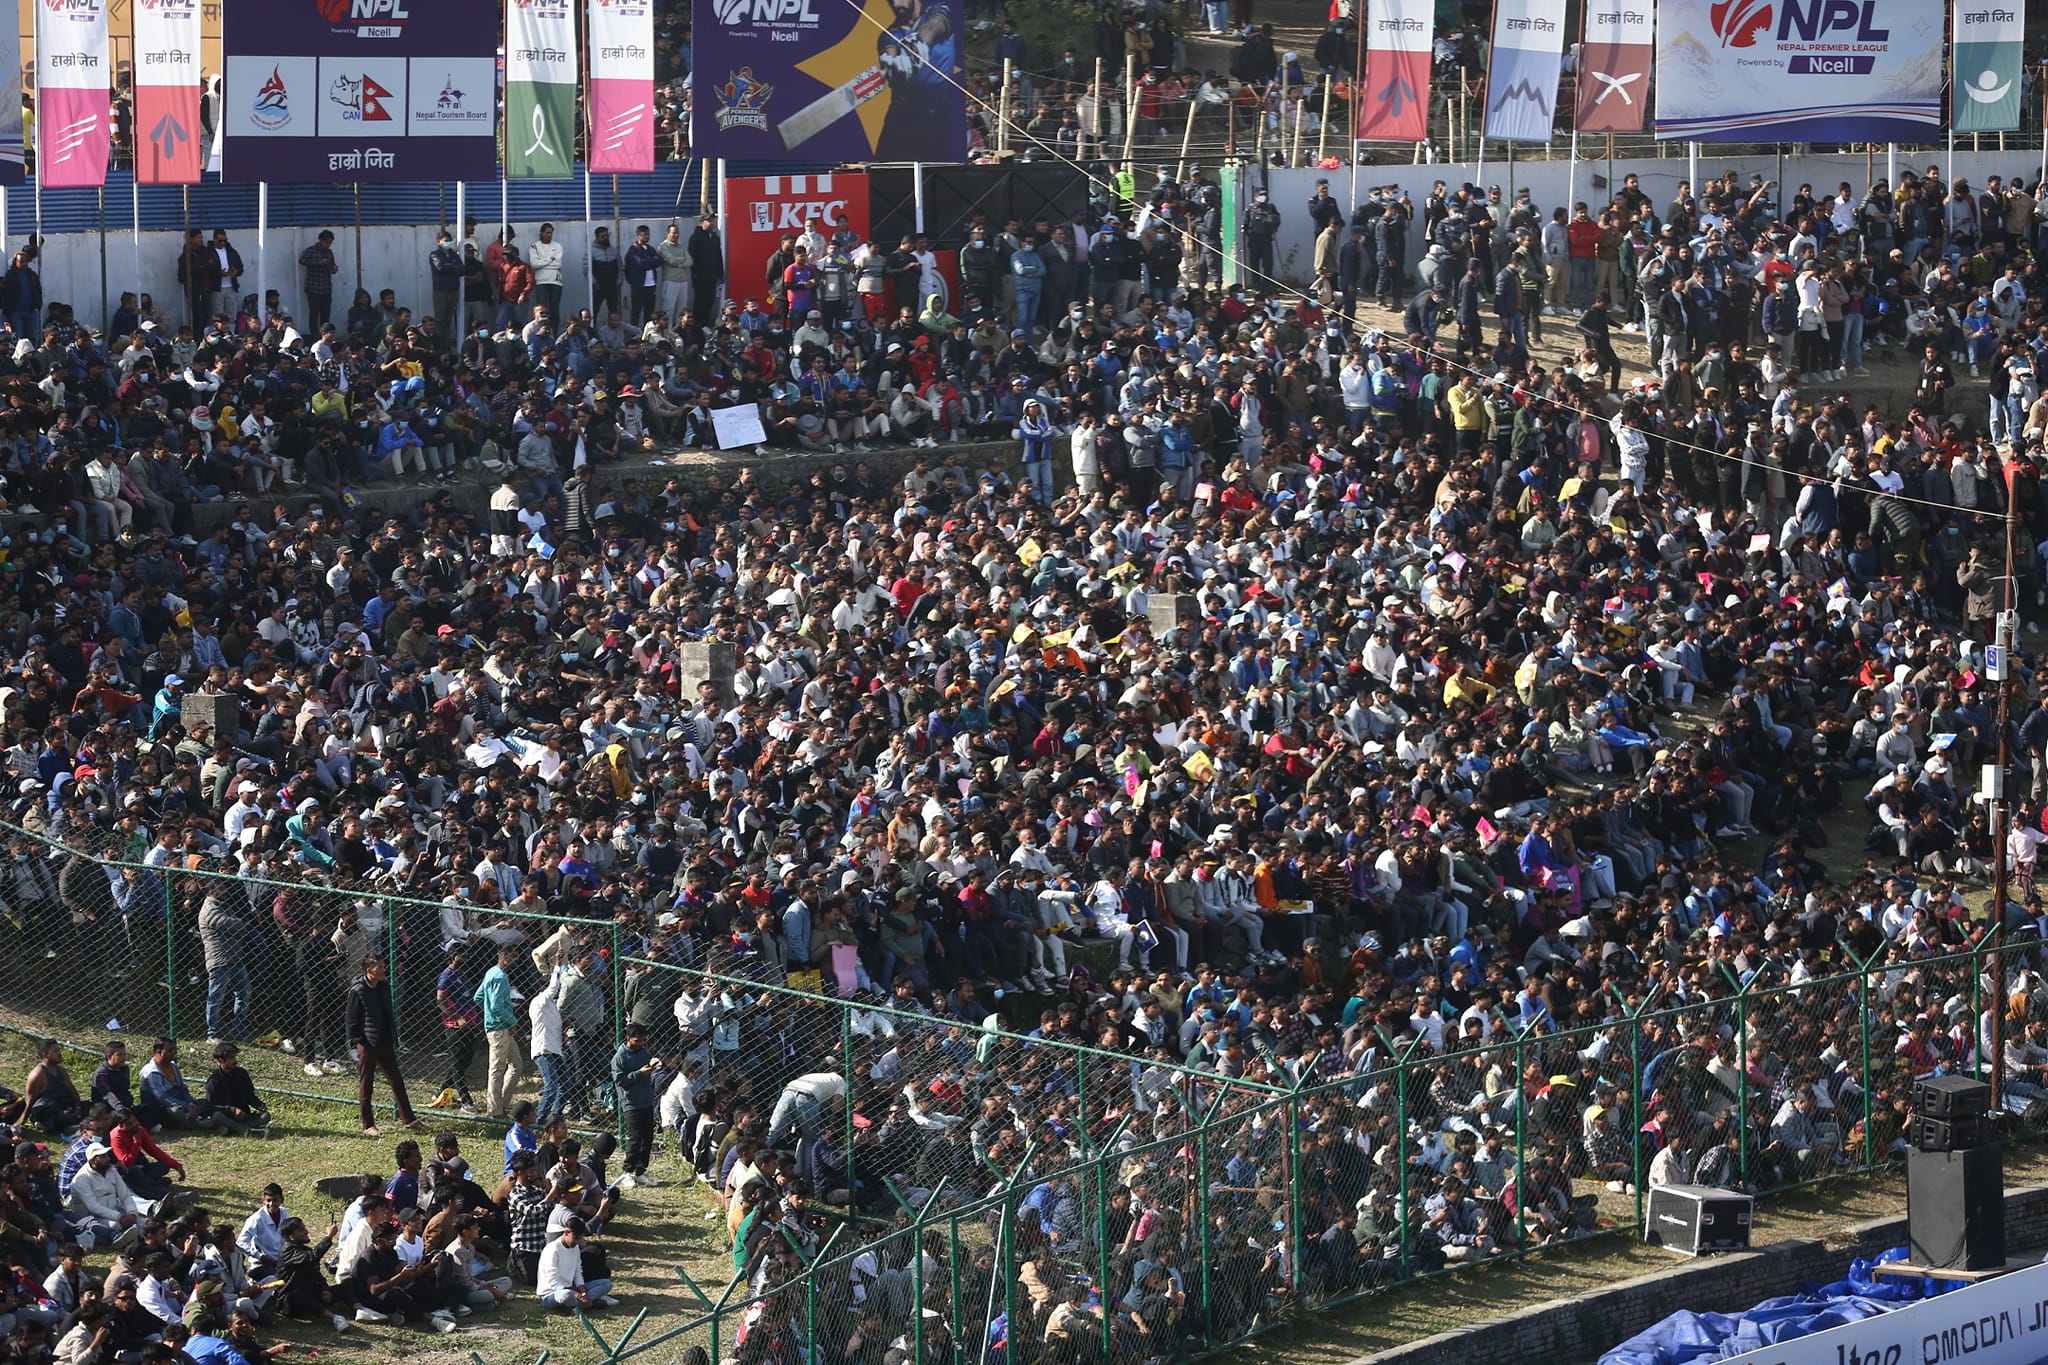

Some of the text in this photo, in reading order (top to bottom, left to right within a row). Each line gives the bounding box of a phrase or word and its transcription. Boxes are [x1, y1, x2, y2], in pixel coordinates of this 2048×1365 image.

[350, 0, 409, 19] NPL
[752, 0, 819, 22] NPL
[1964, 9, 2015, 24] हाम्रो जित
[1402, 18, 1424, 32] जित
[1506, 17, 1556, 32] हाम्रो जित
[1597, 11, 1645, 25] हाम्रो जित
[1777, 0, 1890, 42] NPL
[367, 27, 391, 37] Ncell
[771, 31, 799, 41] Ncell
[516, 48, 566, 63] हाम्रो जित
[601, 45, 646, 60] हाम्रो जित
[1852, 44, 1889, 52] LEAGUE
[51, 53, 76, 67] हाम्रो
[145, 49, 191, 65] हाम्रो जित
[1773, 59, 1784, 67] by
[1809, 57, 1854, 73] Ncell
[343, 111, 361, 120] CAN
[415, 112, 436, 120] Nepal
[722, 114, 766, 129] AVENGERS
[328, 148, 395, 170] हाम्रो जित
[777, 200, 846, 229] KFC
[1922, 1311, 2014, 1365] OMODA
